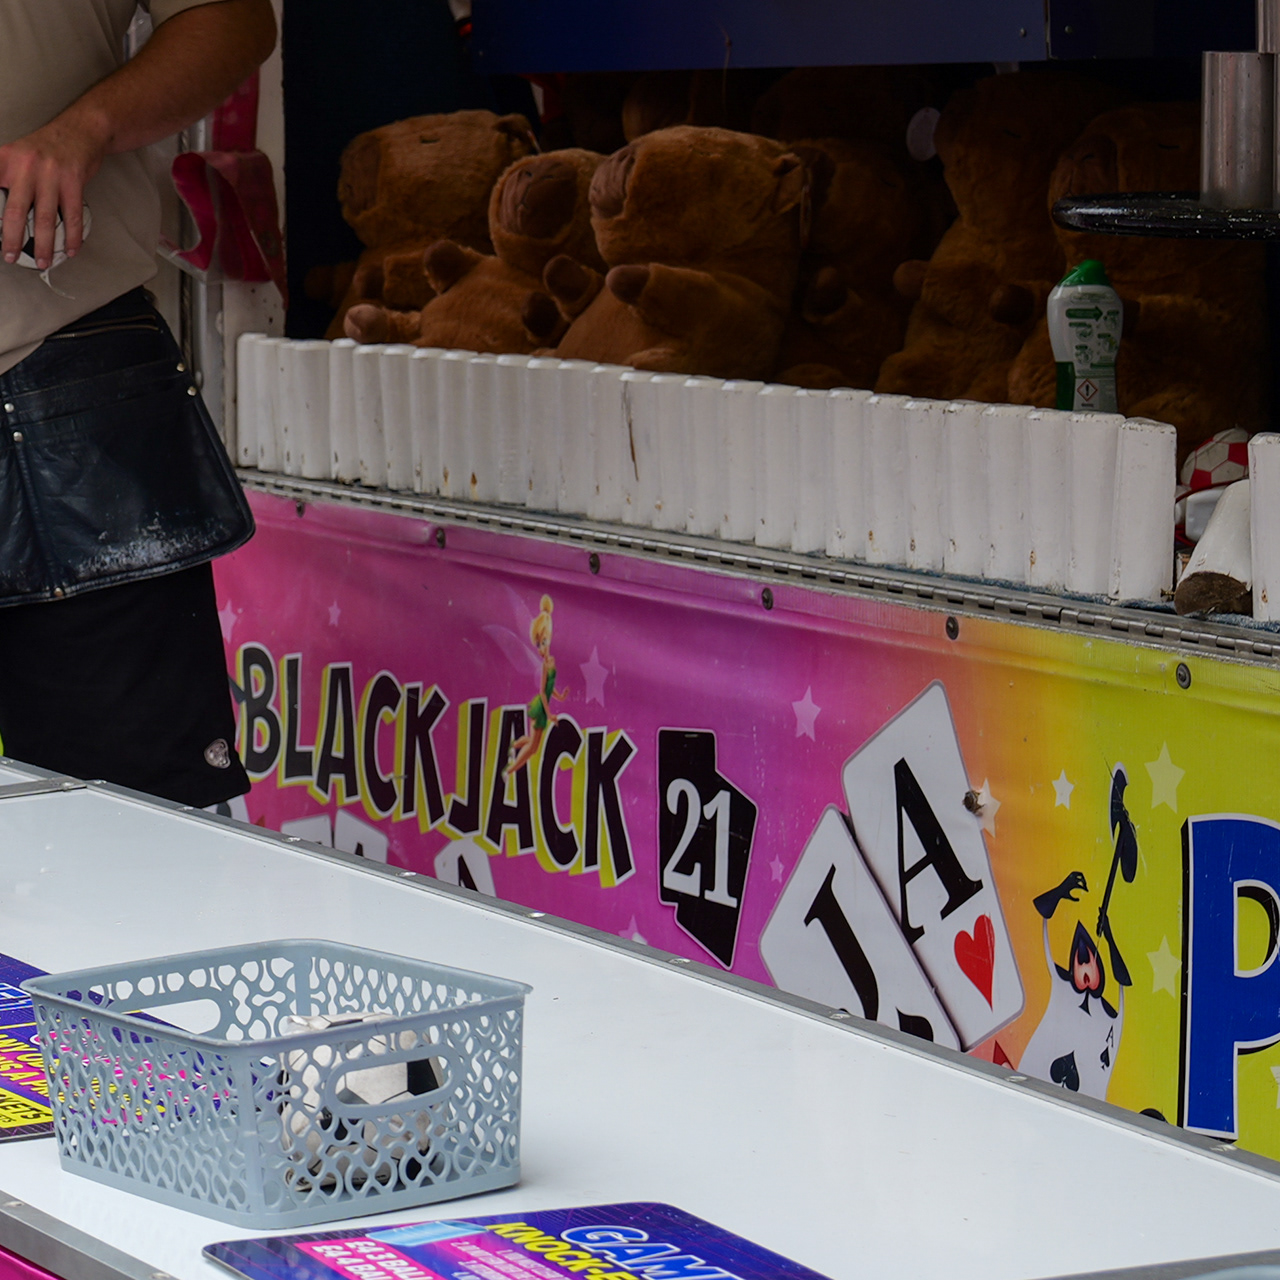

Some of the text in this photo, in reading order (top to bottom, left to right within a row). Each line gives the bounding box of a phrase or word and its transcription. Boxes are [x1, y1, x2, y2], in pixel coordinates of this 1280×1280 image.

[237, 642, 638, 888] BLACKJACK
[662, 777, 740, 908] 21
[893, 757, 984, 945] A
[0, 1071, 40, 1081] A
[1106, 1024, 1114, 1048] A
